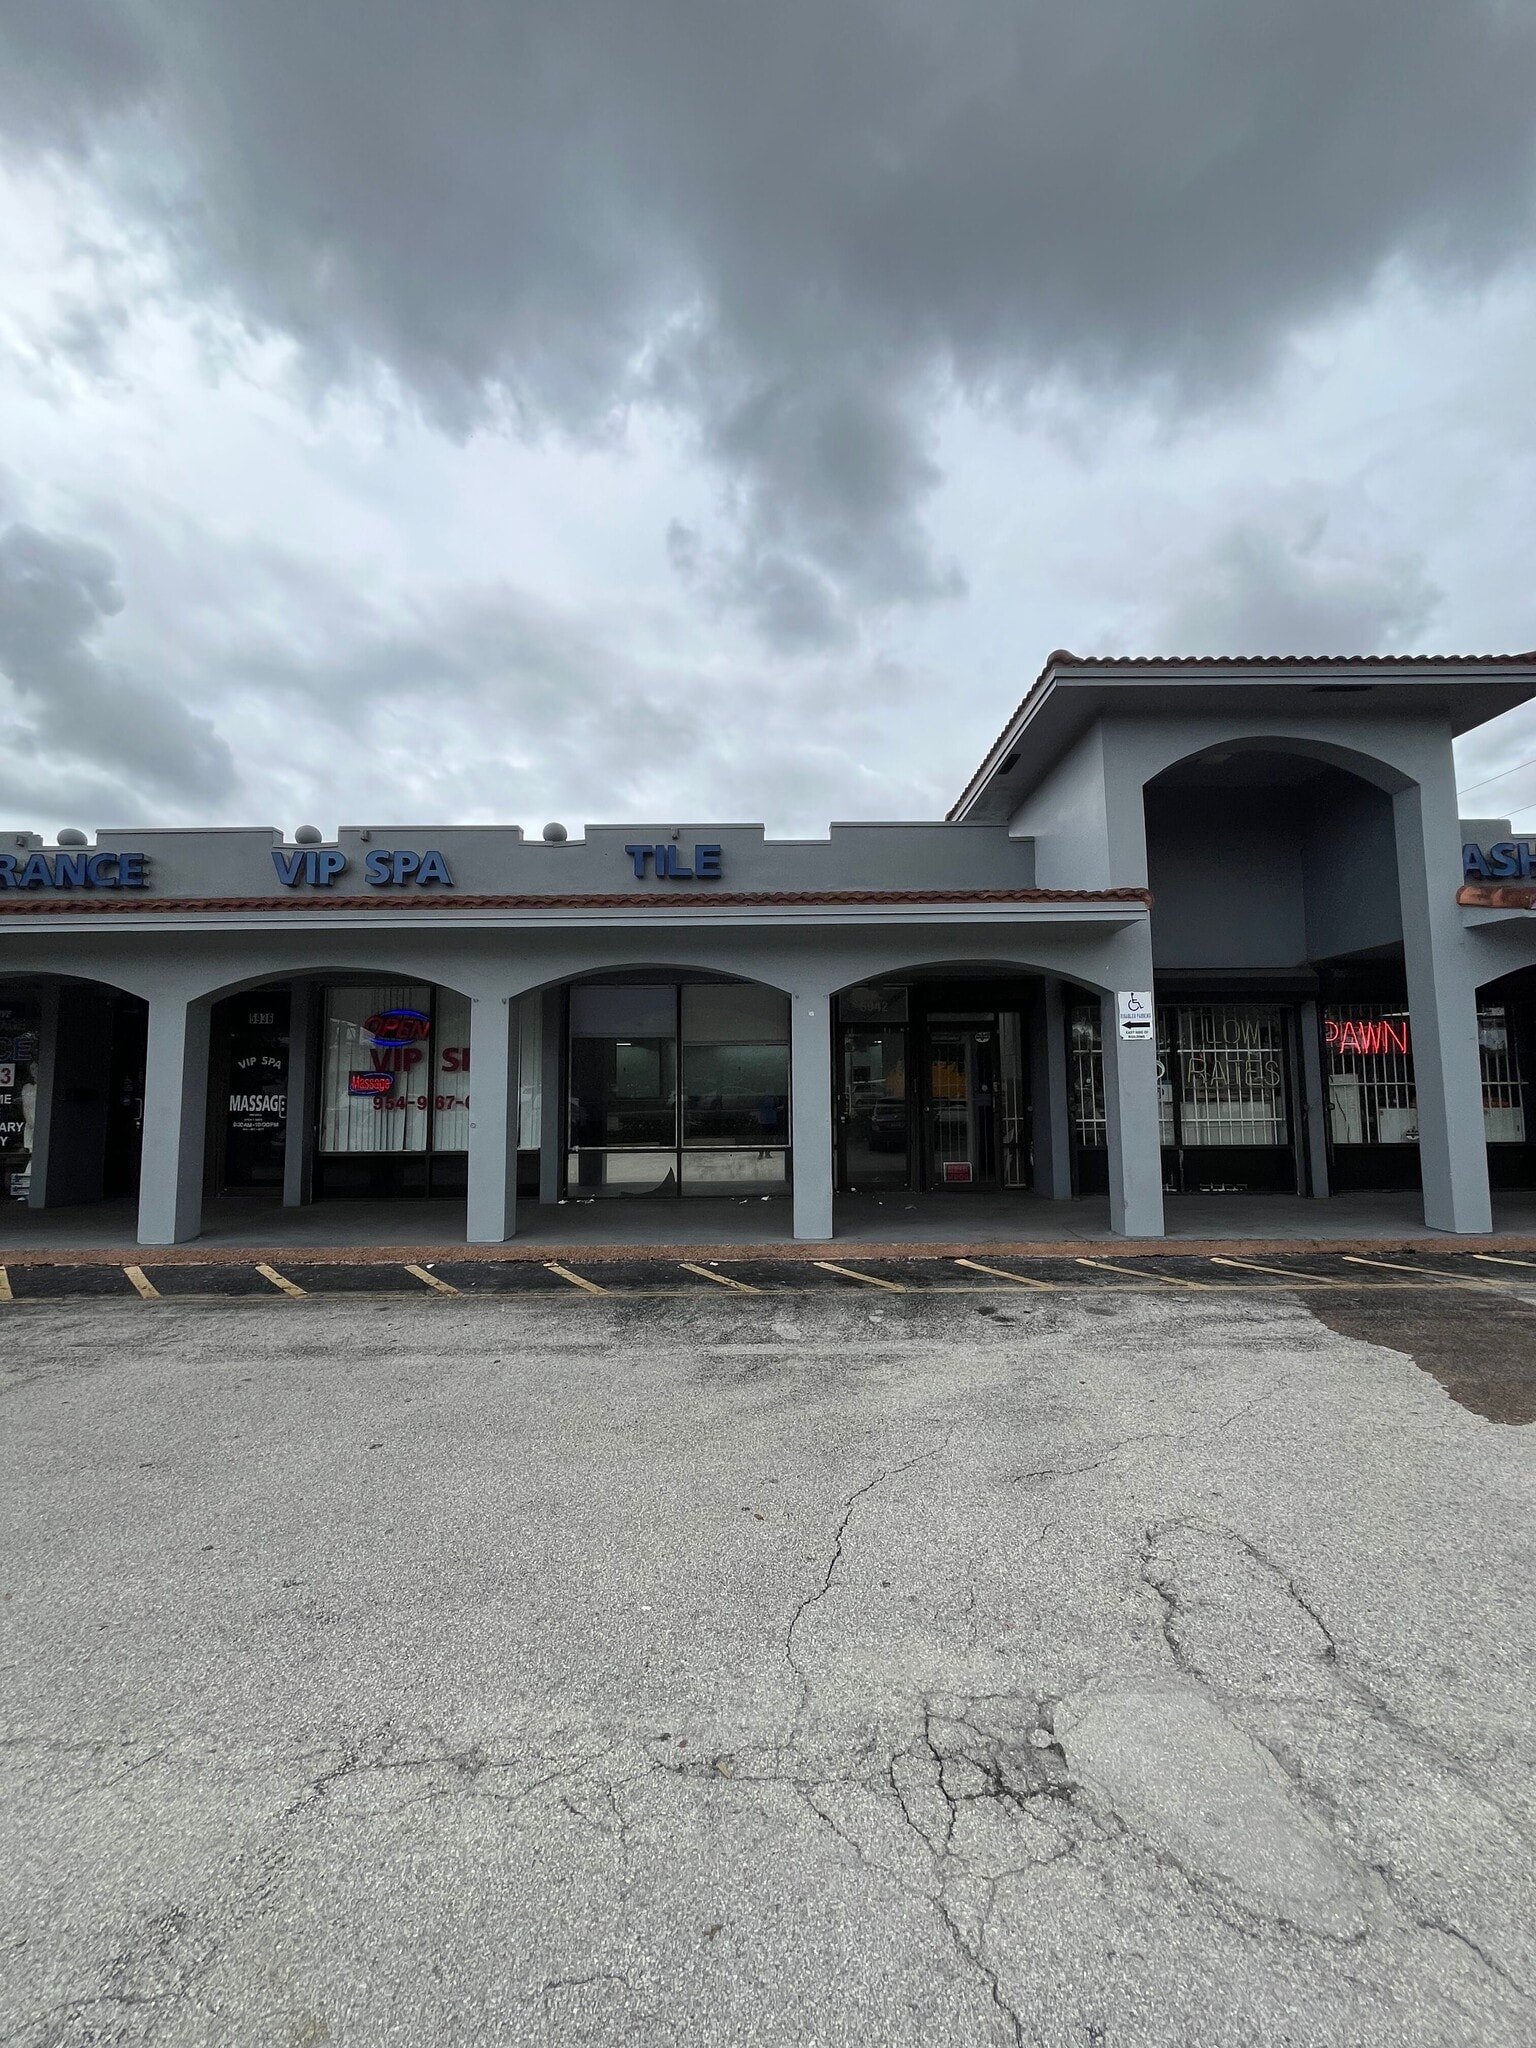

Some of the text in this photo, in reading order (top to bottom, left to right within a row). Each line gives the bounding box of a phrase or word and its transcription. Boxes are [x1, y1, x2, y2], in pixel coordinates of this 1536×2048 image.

[272, 850, 453, 886] VIP SPA
[625, 844, 721, 879] TILE
[364, 1015, 431, 1041] OPEN
[1205, 1019, 1261, 1045] LOW
[237, 1056, 282, 1070] VIP SPA
[370, 1048, 423, 1072] VIP
[1188, 1058, 1281, 1087] RATES
[352, 1075, 390, 1091] Massage
